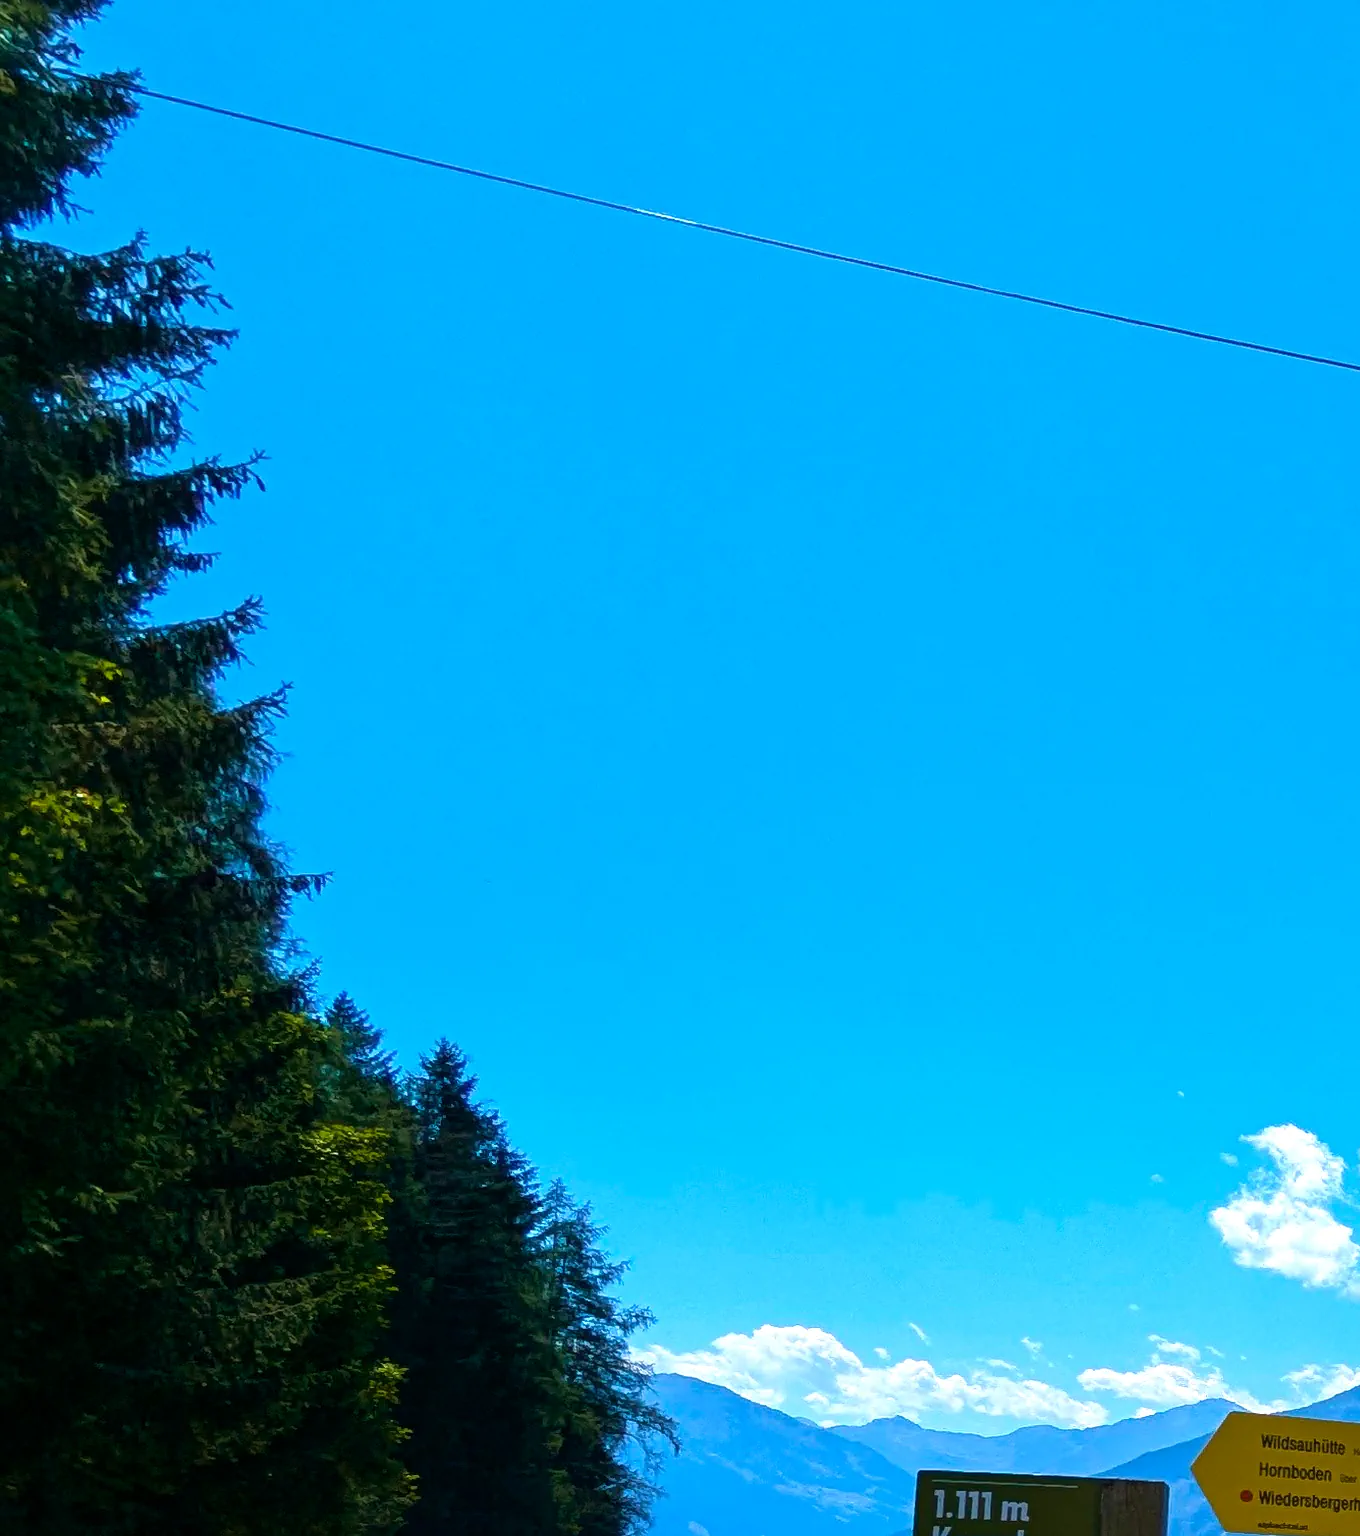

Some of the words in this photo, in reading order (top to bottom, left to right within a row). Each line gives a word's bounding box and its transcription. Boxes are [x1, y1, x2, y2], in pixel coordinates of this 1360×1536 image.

[1261, 1433, 1346, 1456] Wildsauhütte
[1259, 1462, 1332, 1482] Hornboden
[934, 1489, 992, 1520] 1.111
[1001, 1500, 1030, 1522] m
